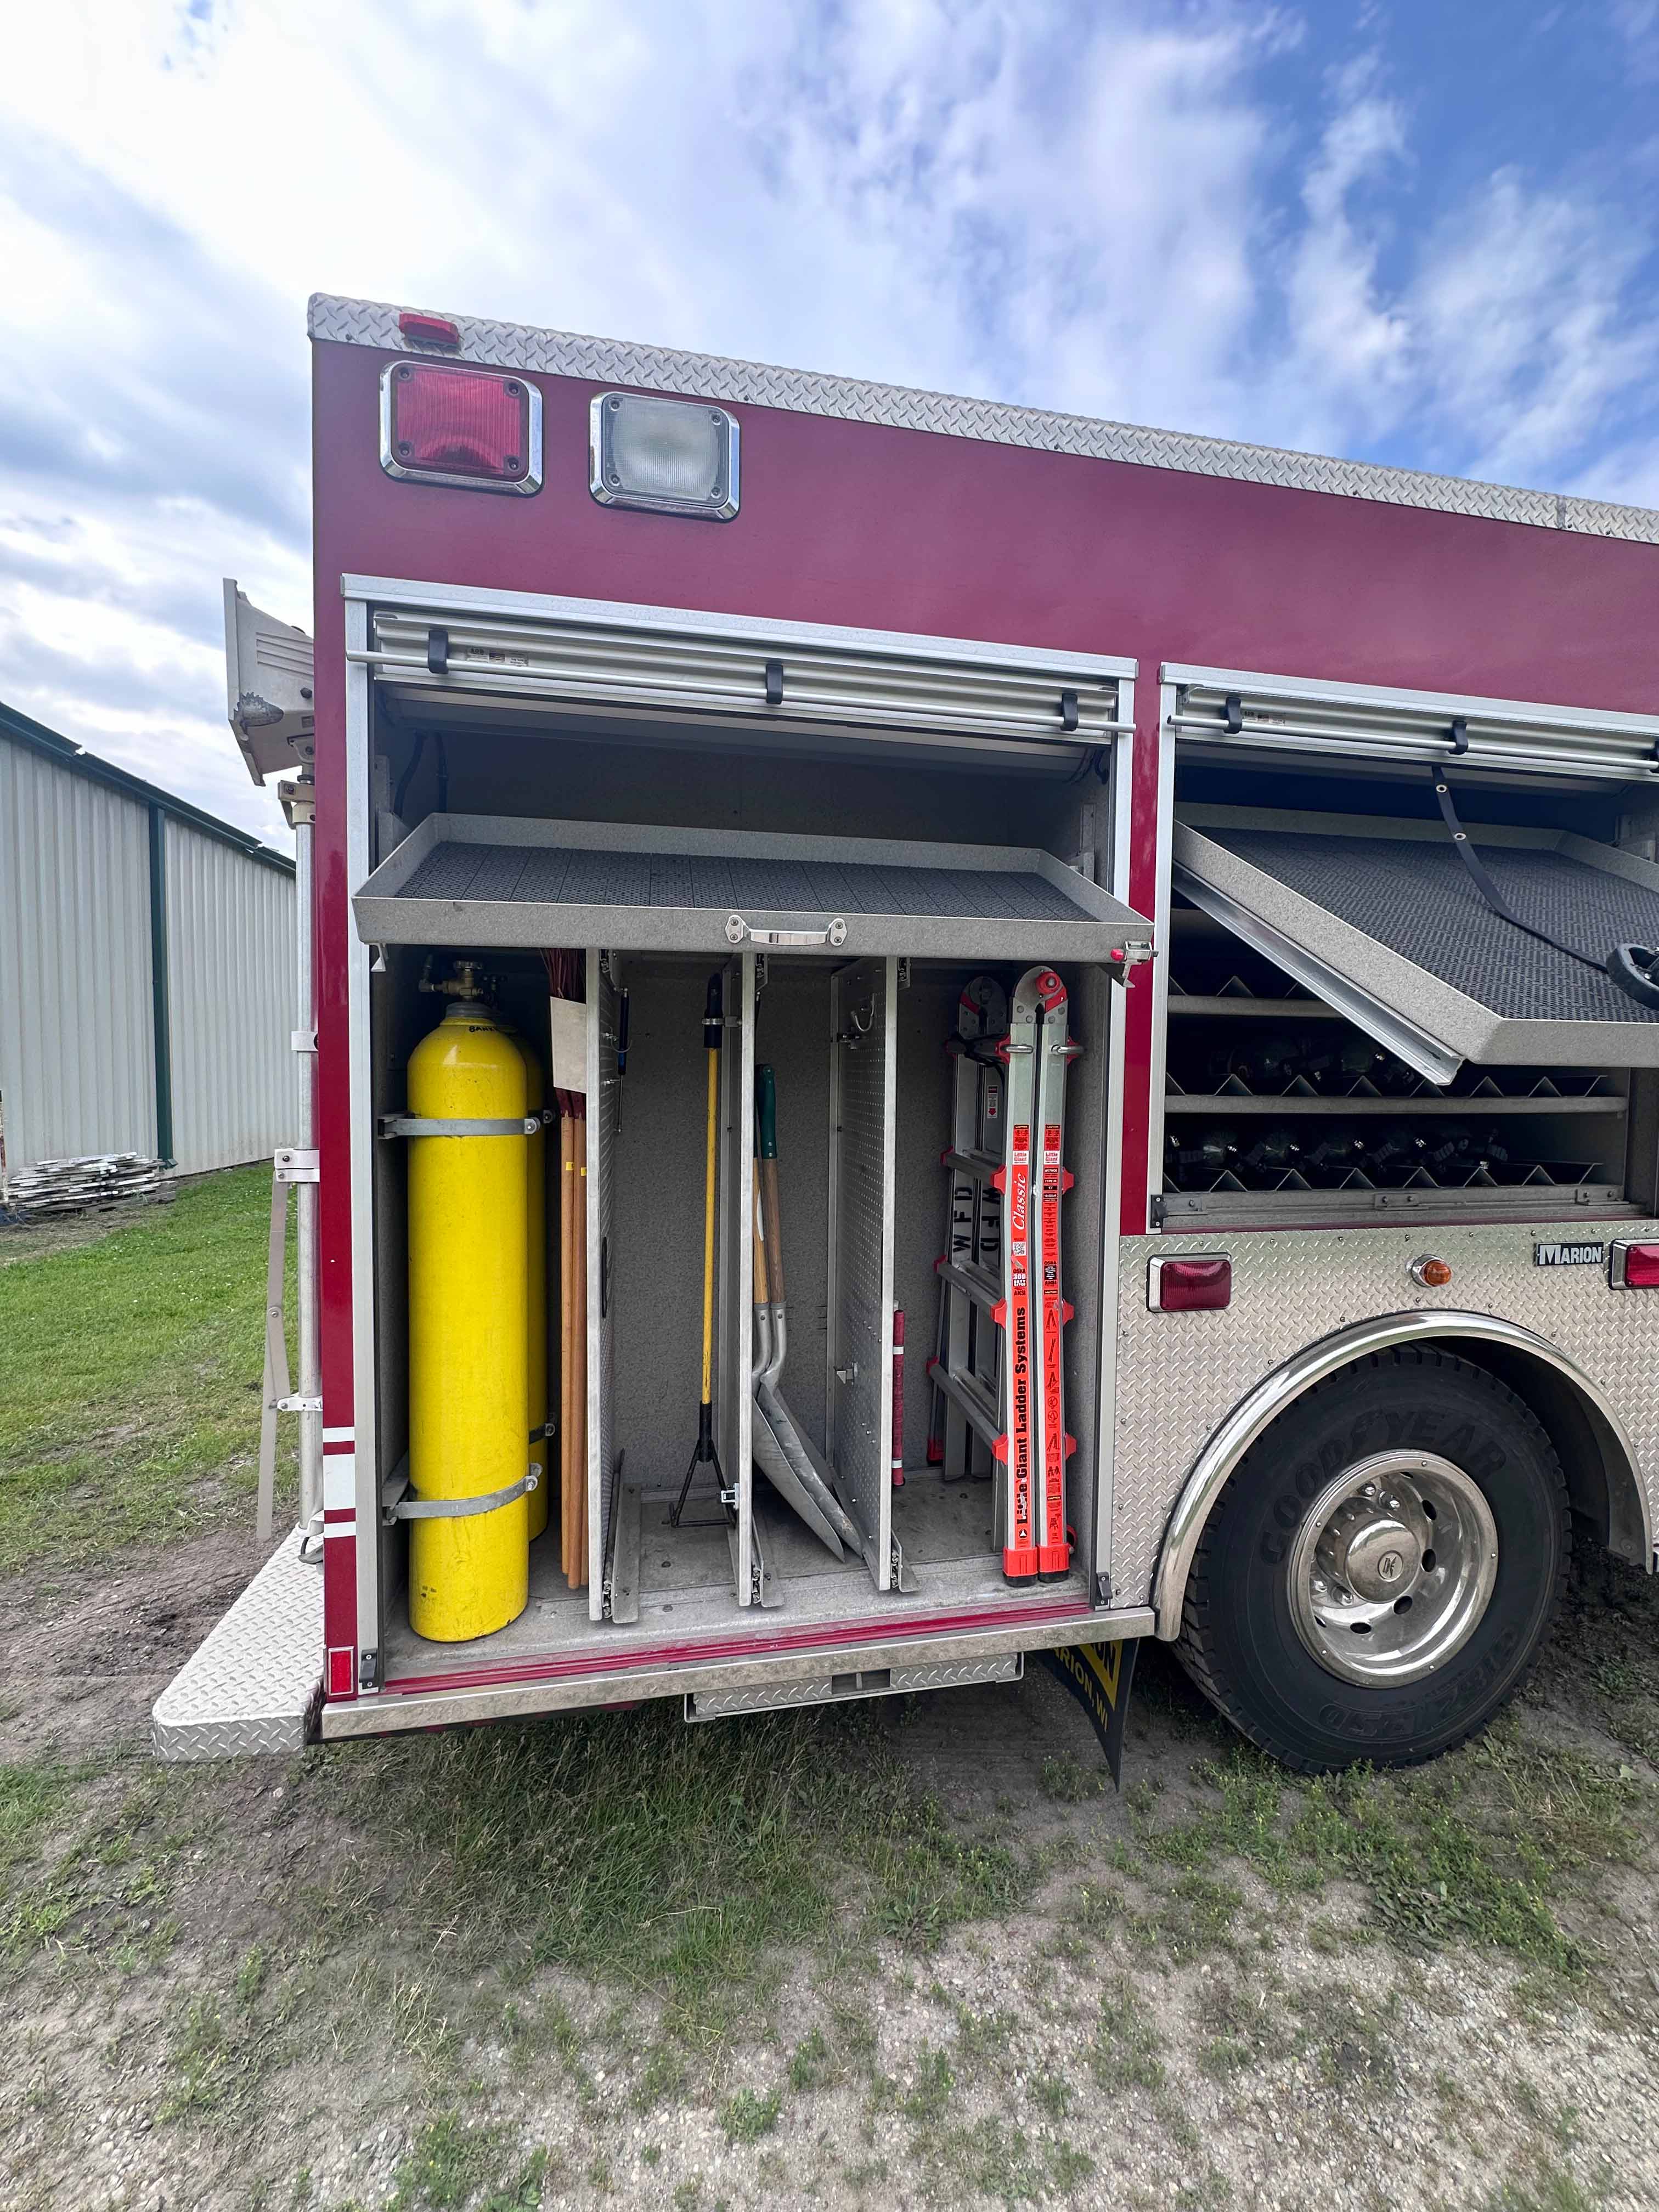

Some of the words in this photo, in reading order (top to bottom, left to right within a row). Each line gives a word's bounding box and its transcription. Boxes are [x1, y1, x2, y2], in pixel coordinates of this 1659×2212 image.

[1013, 1172, 1026, 1230] Classic
[1539, 1244, 1603, 1265] MARION
[1015, 1307, 1028, 1374] Systems
[1015, 1379, 1027, 1433] Ladder
[1016, 1438, 1027, 1479] Giant
[1261, 1408, 1508, 1565] GOODYEAR
